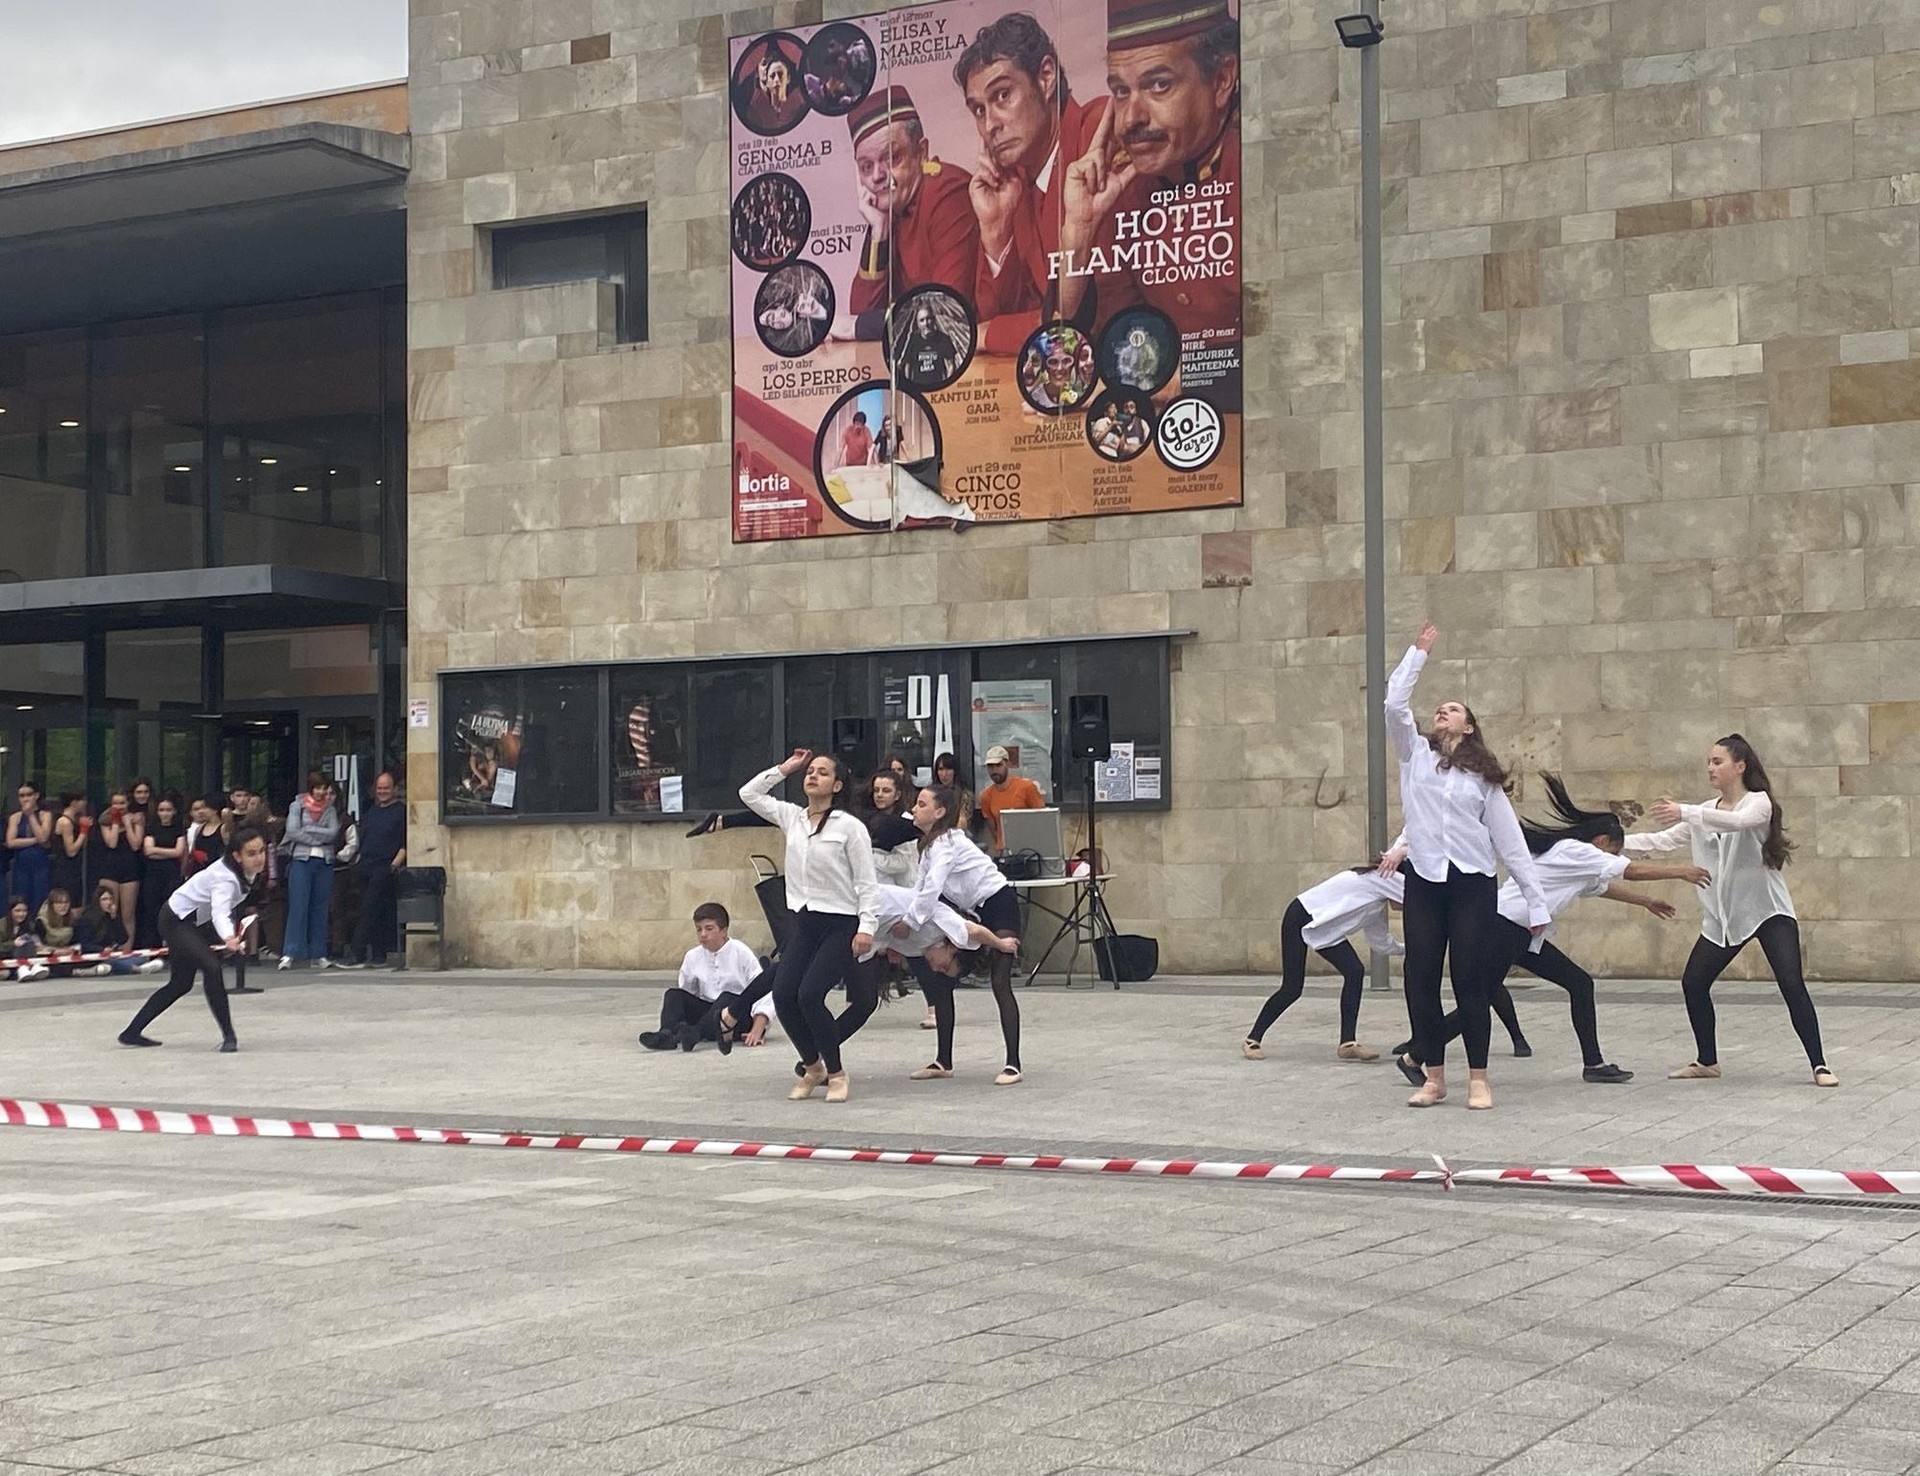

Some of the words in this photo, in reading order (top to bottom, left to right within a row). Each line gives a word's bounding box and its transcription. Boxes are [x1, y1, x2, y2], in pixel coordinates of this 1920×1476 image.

[880, 22, 932, 44] ELISA
[935, 19, 947, 34] Y
[880, 34, 968, 61] MARCELA
[880, 62, 888, 72] A
[738, 142, 816, 167] GENOMA
[821, 140, 832, 155] B
[1150, 186, 1179, 206] api
[1184, 183, 1196, 200] 9
[1200, 180, 1234, 196] abr
[1115, 200, 1234, 240] HOTEL
[811, 235, 852, 256] OSN
[1047, 231, 1234, 280] FLAMINGO
[1141, 260, 1234, 286] CLOWNIC
[1181, 340, 1206, 351] NIRE
[1181, 348, 1235, 362] BILDURRIK
[762, 362, 778, 374] api
[780, 360, 793, 370] 30
[795, 359, 814, 368] abr
[1182, 359, 1240, 373] MAITEENAK
[763, 373, 796, 390] LOS
[800, 365, 872, 387] PERROS
[930, 391, 971, 404] KANTU
[974, 388, 998, 400] BAT
[966, 402, 1000, 415] GARA
[955, 473, 1022, 493] CINCO
